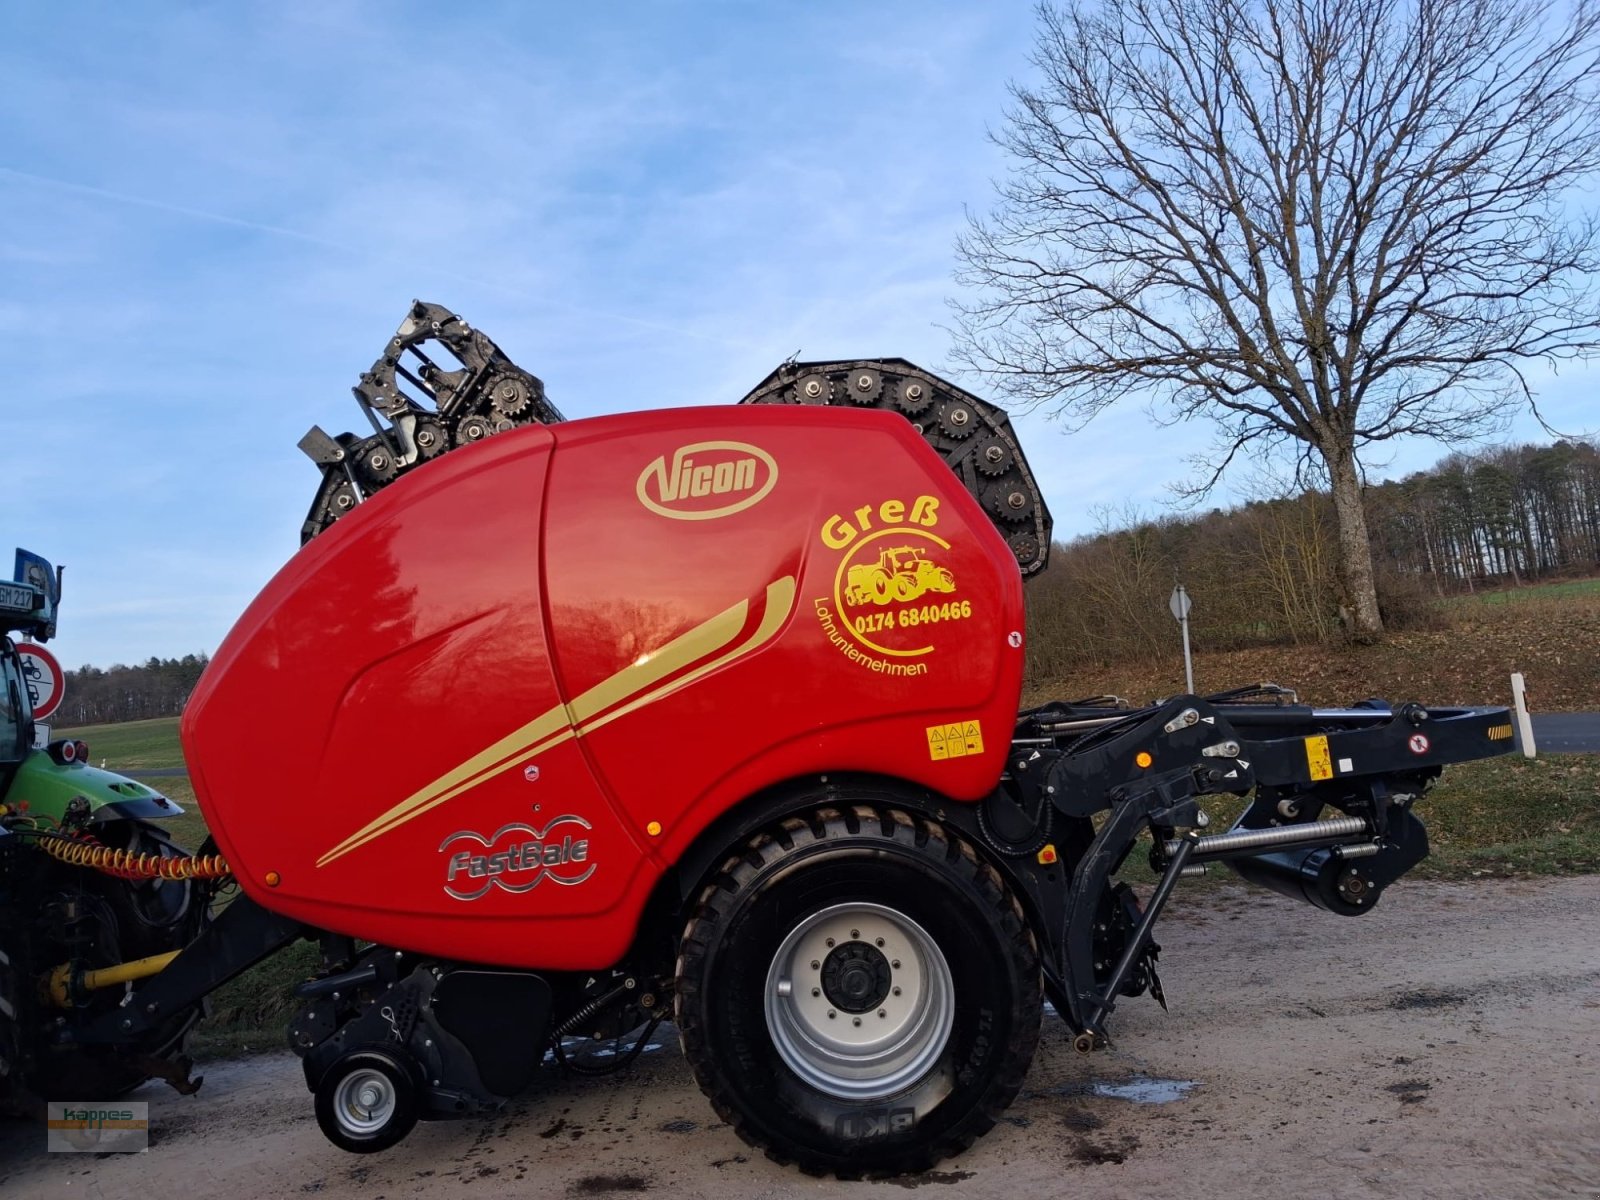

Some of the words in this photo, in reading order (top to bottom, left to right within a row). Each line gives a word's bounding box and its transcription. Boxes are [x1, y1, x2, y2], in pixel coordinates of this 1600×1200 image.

[655, 452, 757, 503] Vicon
[820, 495, 941, 551] Greß
[14, 590, 32, 607] 217
[855, 611, 895, 634] 0174
[898, 600, 972, 629] 6840466
[814, 596, 928, 677] Lohnunternehmen
[447, 835, 588, 881] FastBale
